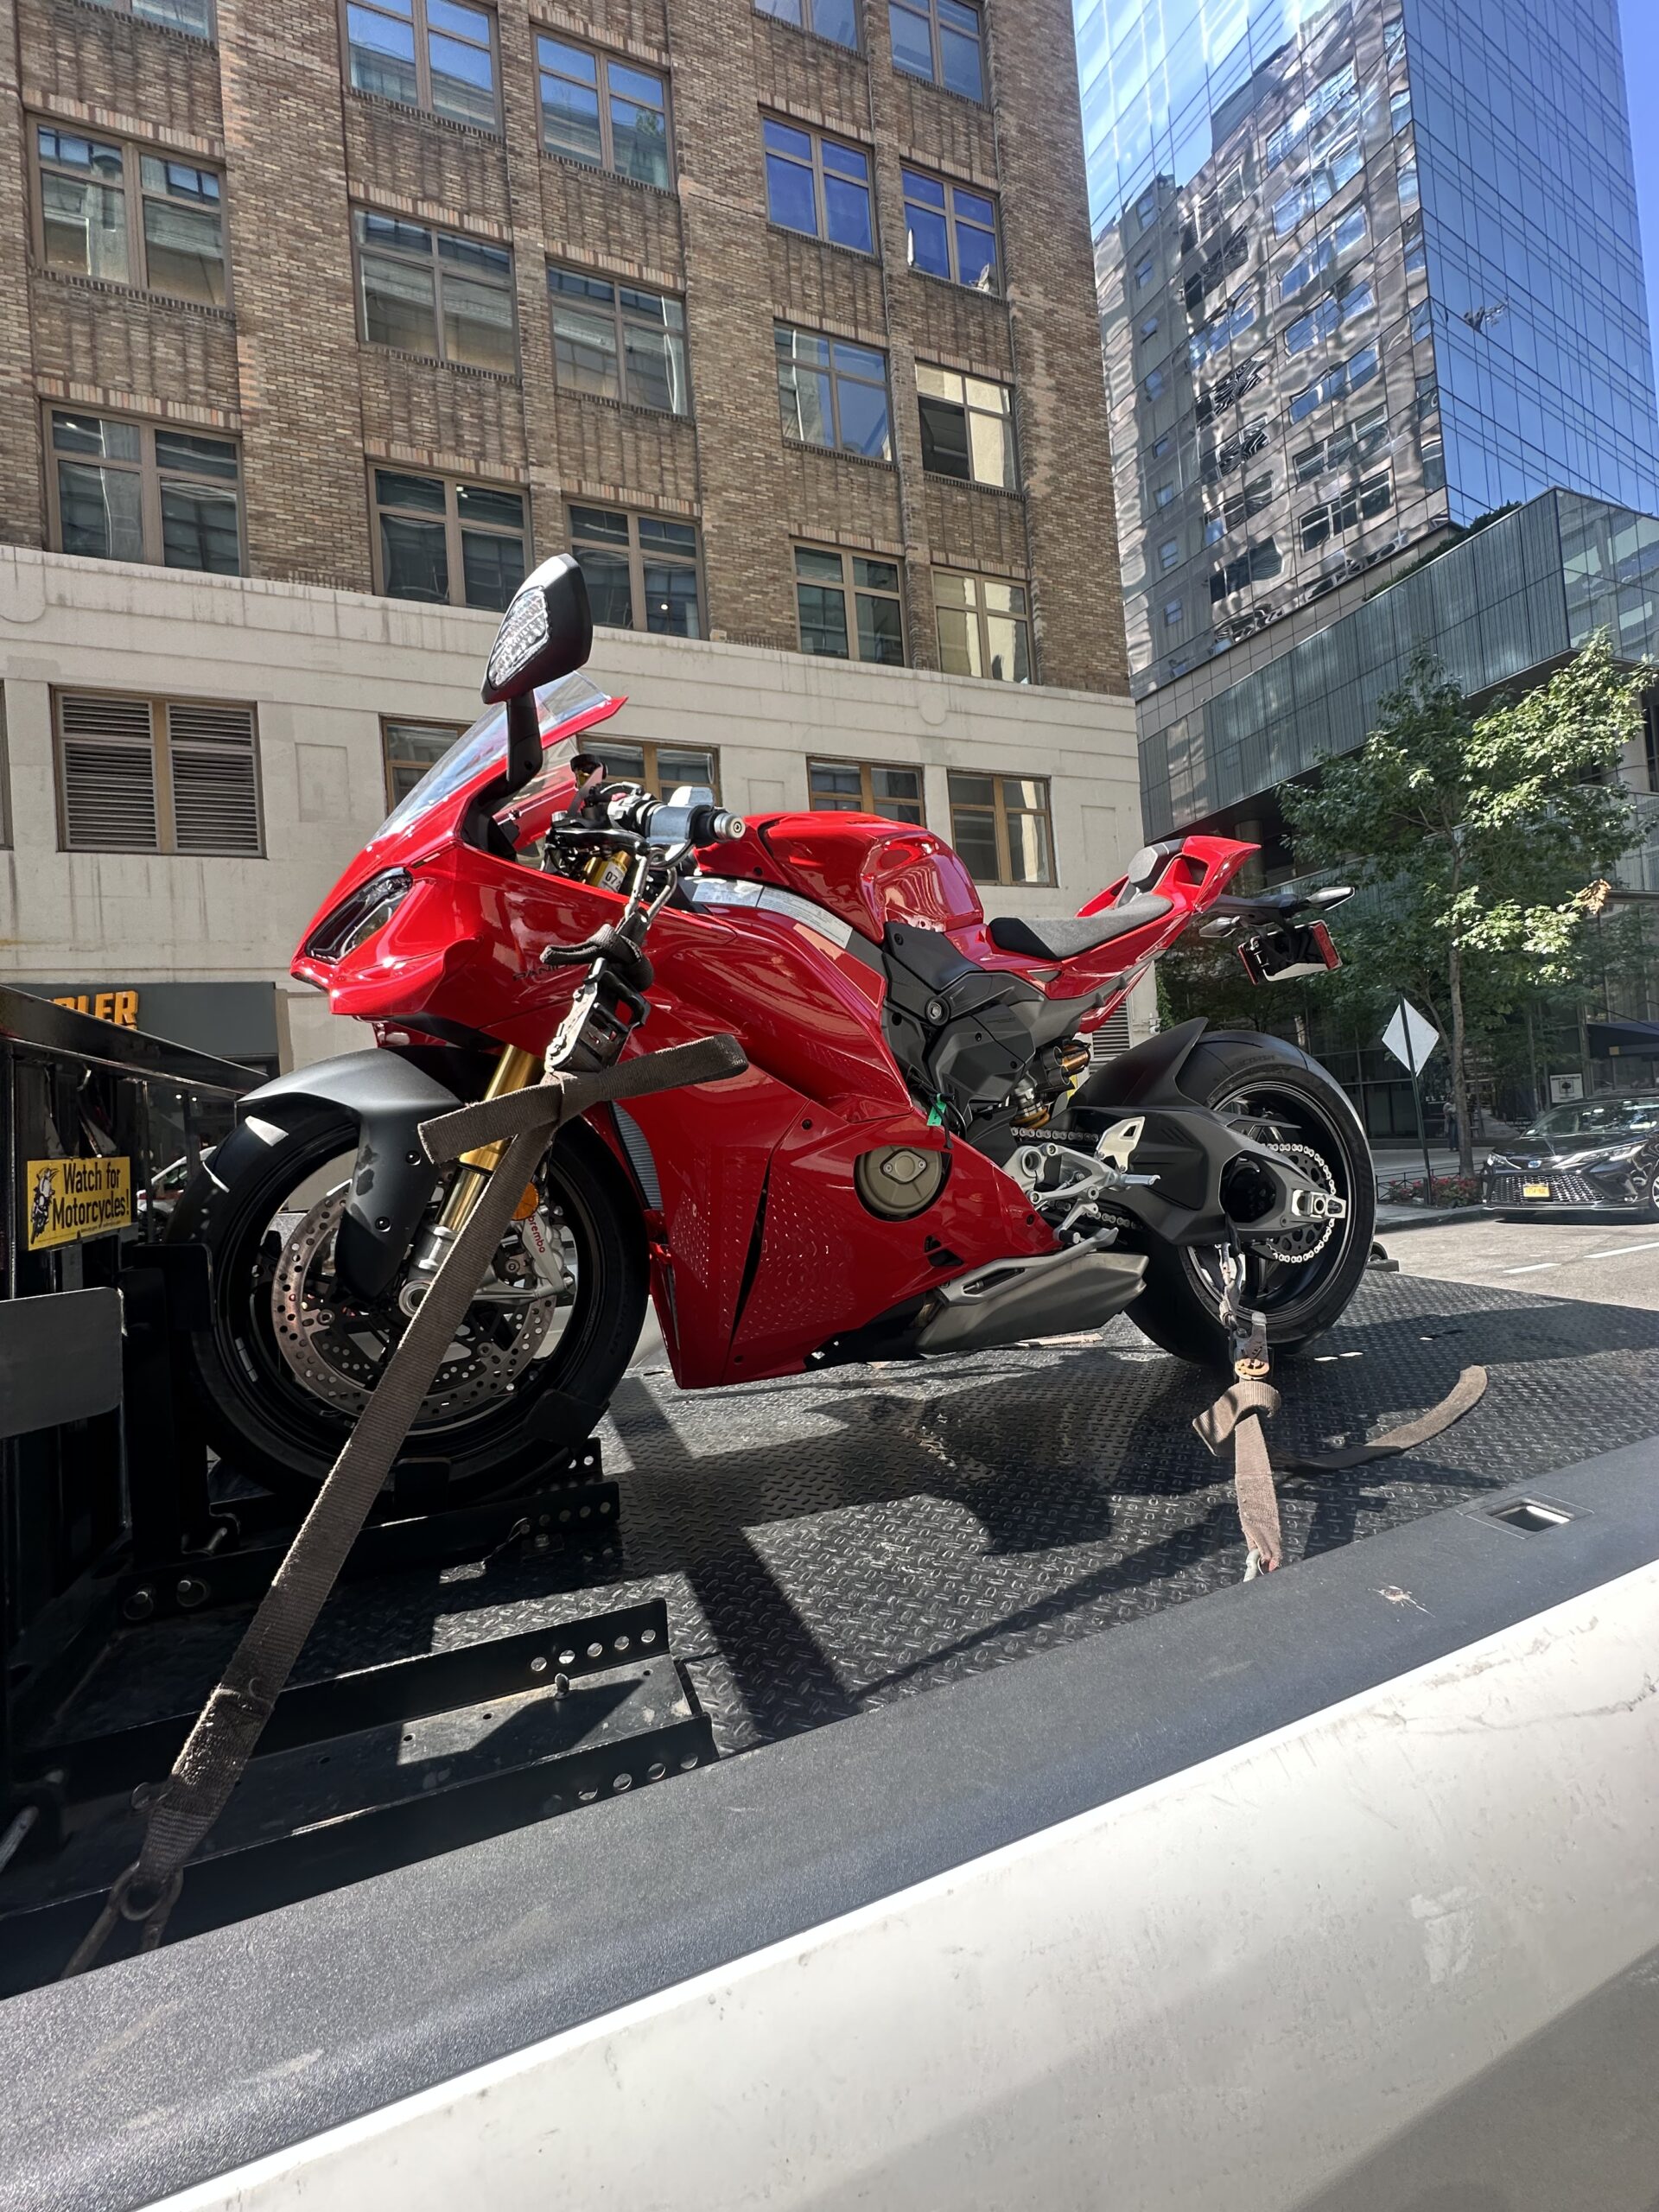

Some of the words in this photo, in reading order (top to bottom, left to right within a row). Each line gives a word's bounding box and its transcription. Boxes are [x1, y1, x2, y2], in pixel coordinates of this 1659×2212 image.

[605, 871, 618, 885] 07
[63, 1162, 102, 1194] Watch
[106, 1161, 120, 1189] for
[53, 1189, 130, 1230] Motorcycles!
[527, 1213, 545, 1253] brembo
